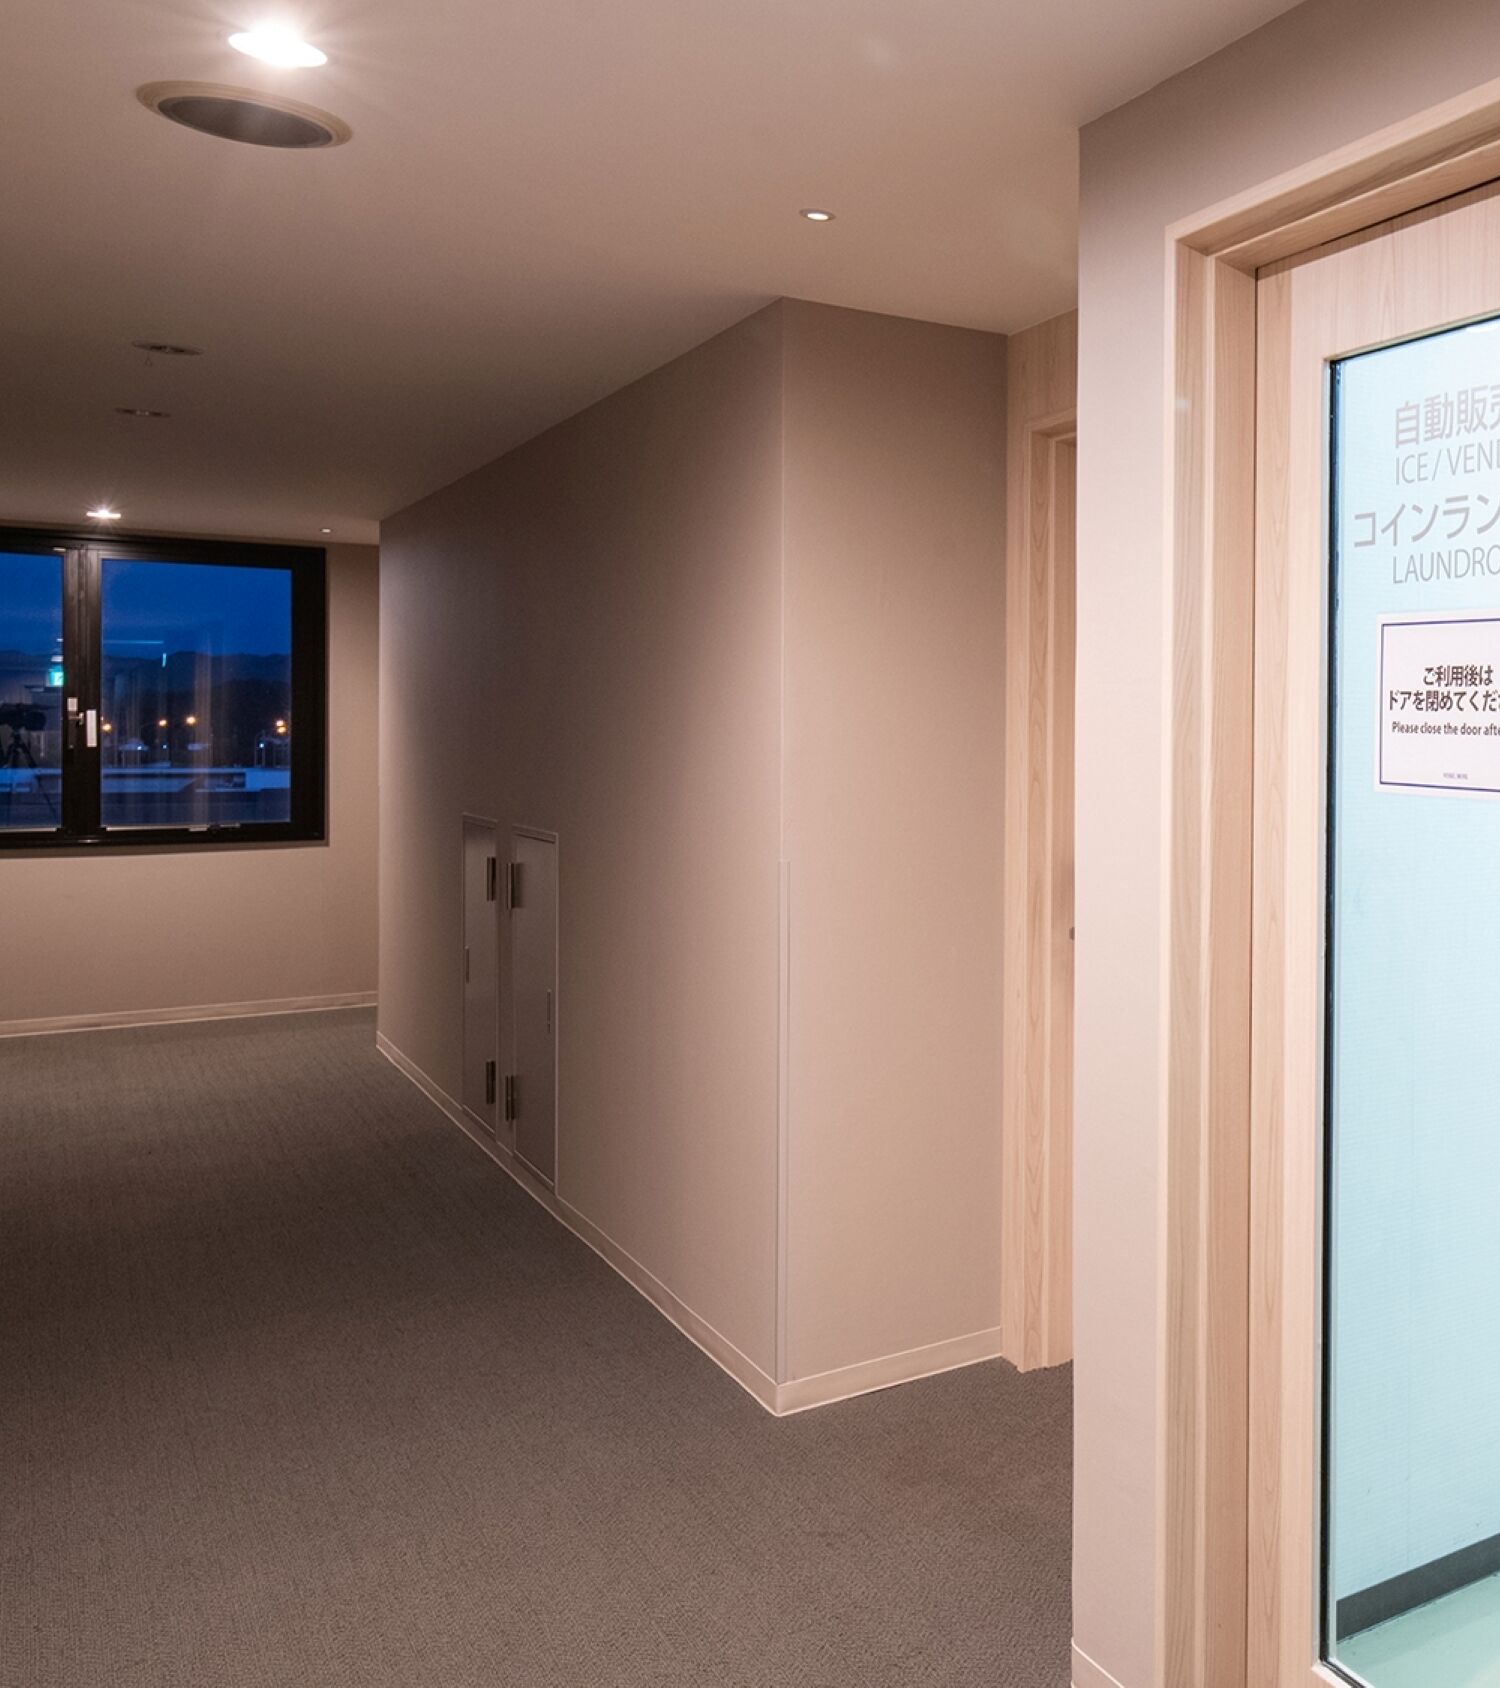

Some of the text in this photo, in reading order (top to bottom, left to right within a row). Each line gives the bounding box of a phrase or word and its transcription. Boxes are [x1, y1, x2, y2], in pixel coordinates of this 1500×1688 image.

[1423, 664, 1493, 687] ご利用後は
[1392, 721, 1419, 733] Please
[1420, 721, 1441, 734] close
[1444, 723, 1459, 735] the
[1460, 723, 1481, 735] door
